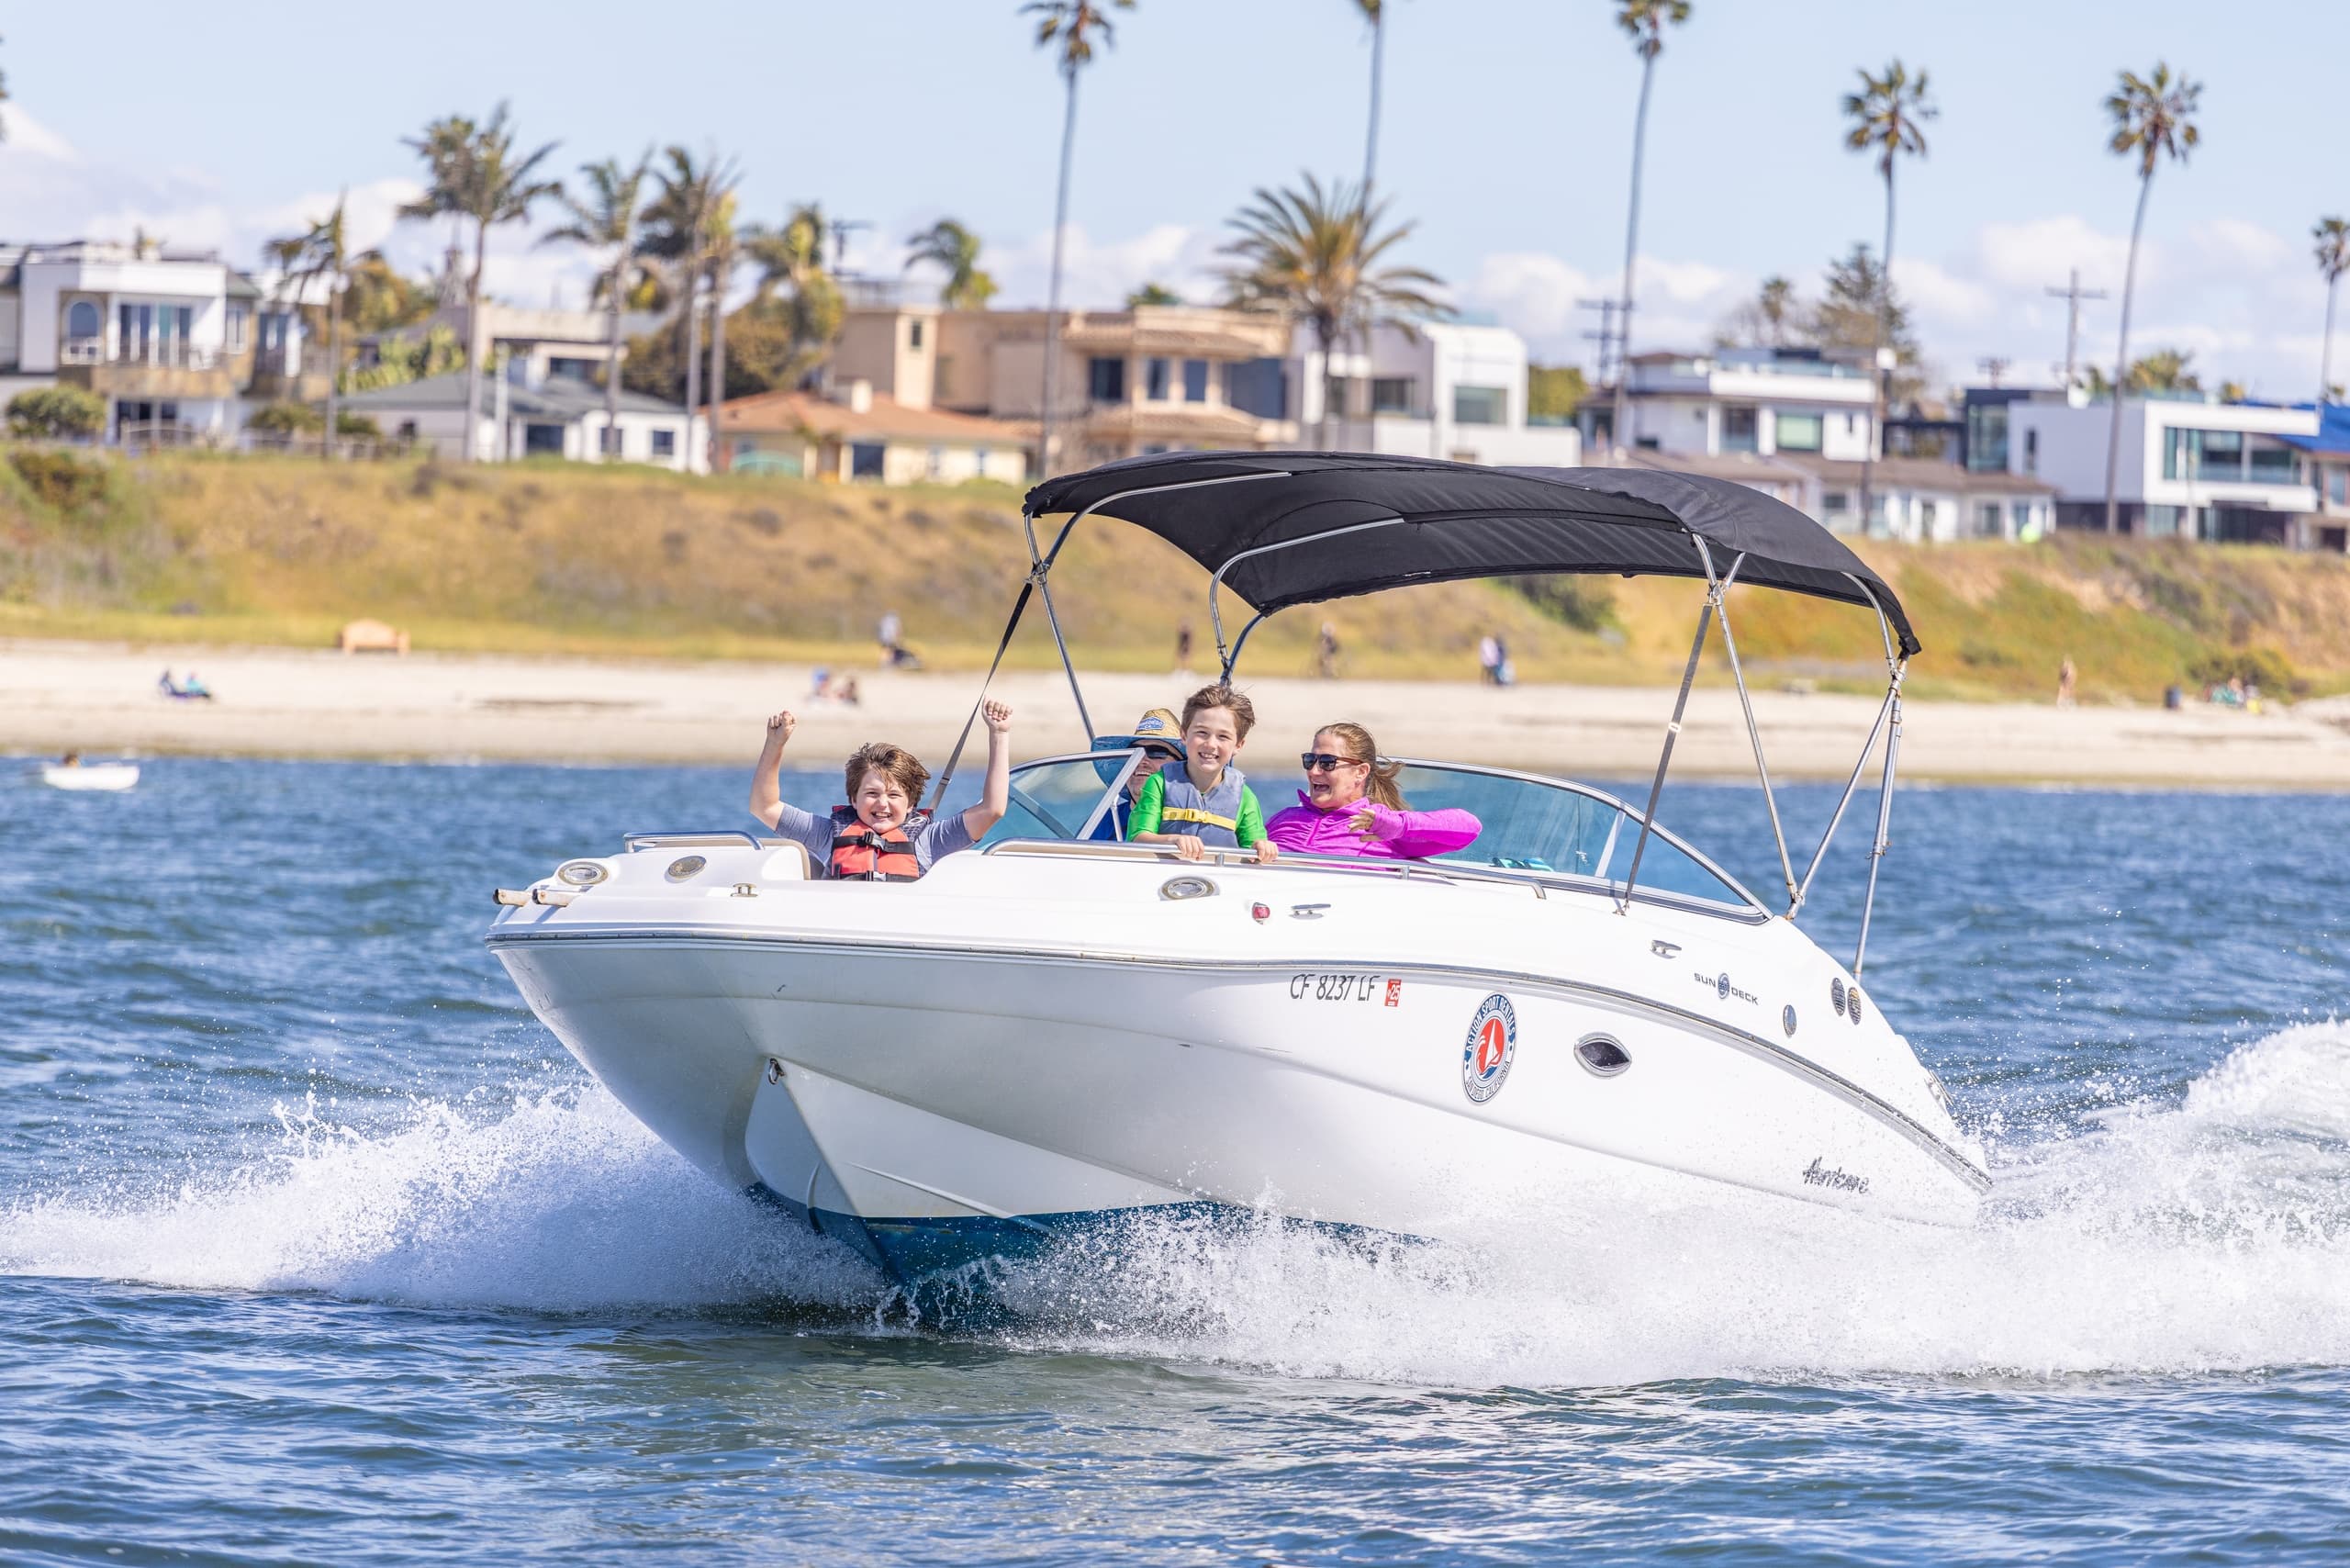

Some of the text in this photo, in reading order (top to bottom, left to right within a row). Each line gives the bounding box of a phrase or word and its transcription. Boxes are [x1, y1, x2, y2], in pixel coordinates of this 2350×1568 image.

[1290, 973, 1381, 1002] CF 8237 LF
[1694, 972, 1759, 1005] SUN DECK
[1465, 995, 1516, 1052] ACTION SPORT RENTALS
[1466, 1076, 1475, 1092] SAN
[1485, 1060, 1510, 1098] CALIFORNIA
